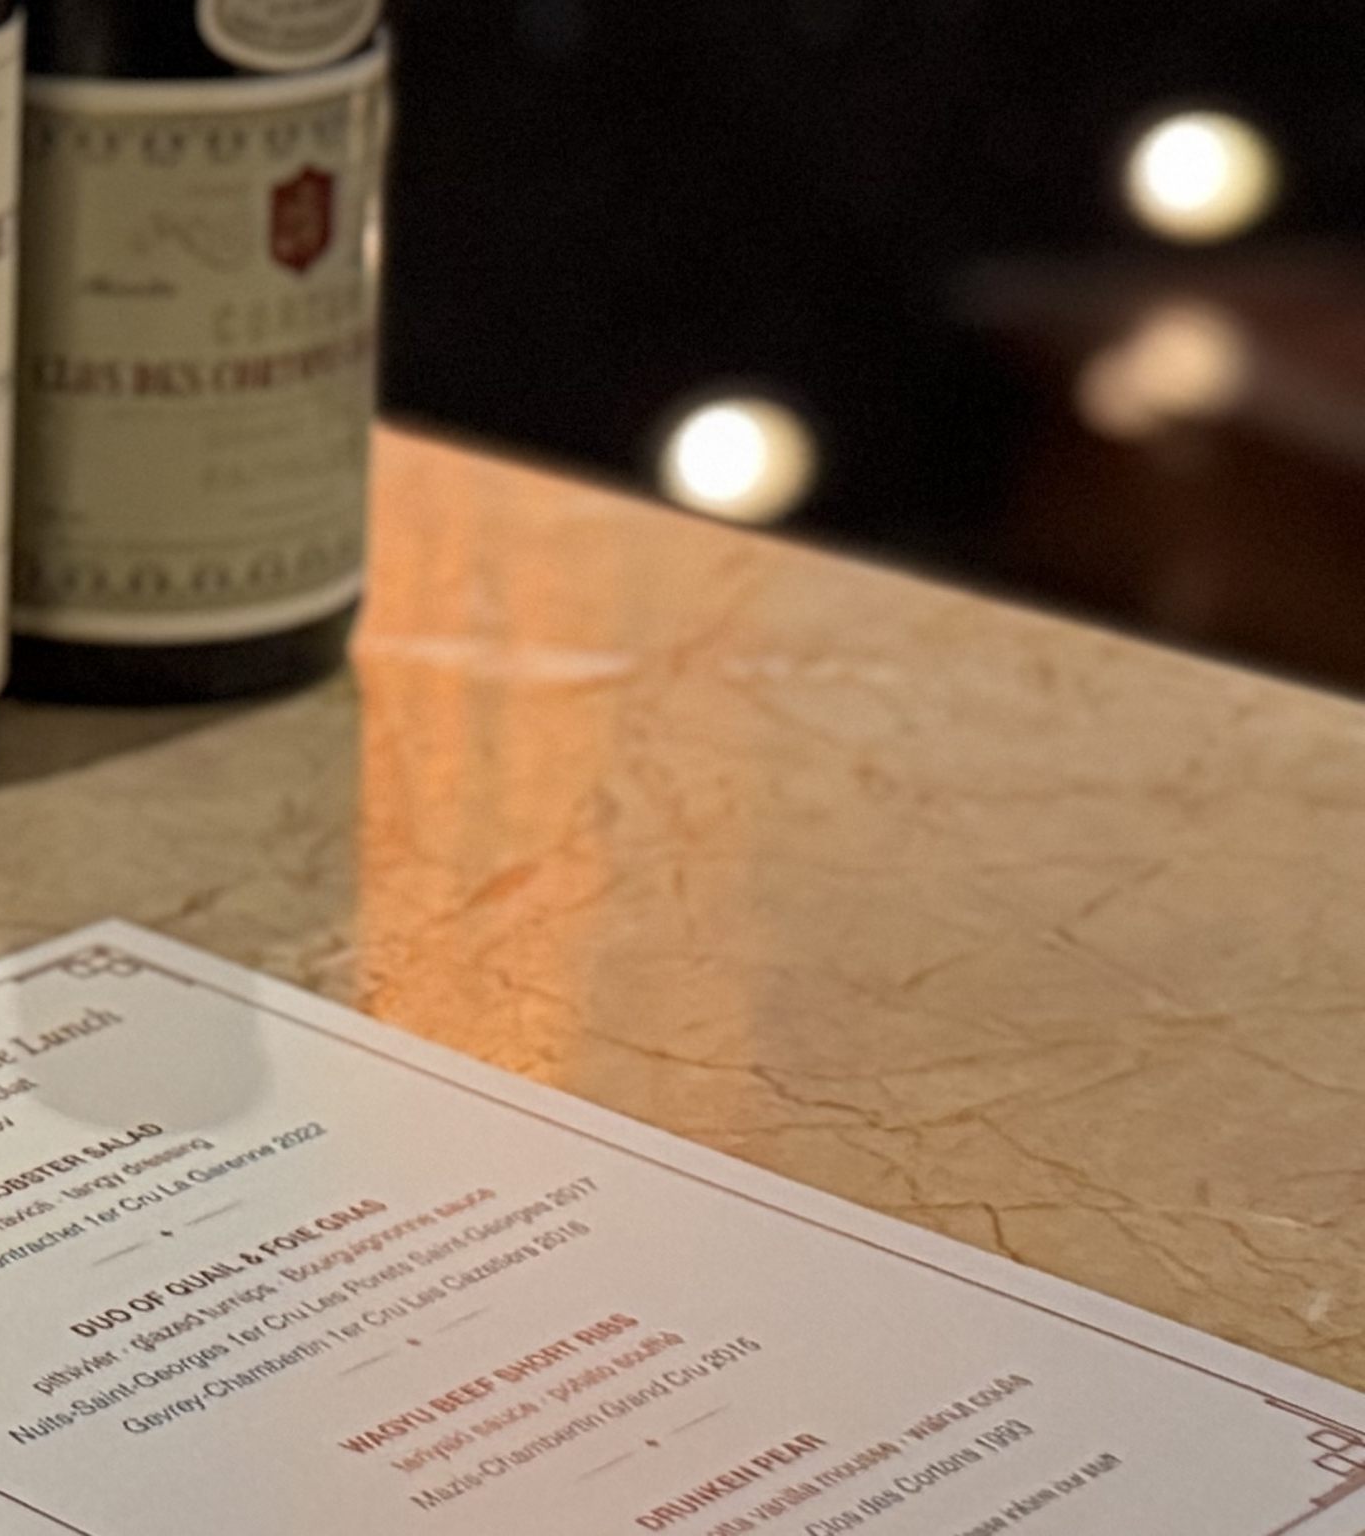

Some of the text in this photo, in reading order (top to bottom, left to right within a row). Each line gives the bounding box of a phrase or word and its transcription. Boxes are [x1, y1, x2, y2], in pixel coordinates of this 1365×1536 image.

[12, 1004, 124, 1058] Lunch
[61, 1171, 127, 1206] tangy
[81, 1121, 165, 1161] SALAD
[83, 1206, 120, 1230] 1er
[119, 1190, 164, 1213] Cru
[161, 1177, 191, 1197] La
[186, 1144, 275, 1185] Garenne
[271, 1120, 328, 1150] 2022
[8, 1343, 230, 1445] Nuits-Saint-Georges
[226, 1326, 267, 1347] 1er
[262, 1307, 310, 1332] Cru
[302, 1289, 348, 1314] Les
[545, 1176, 599, 1207] 2017
[70, 1198, 389, 1339] DUO OF QUAIL & FOIE GRAS
[122, 1334, 330, 1435] Gevrey-Chambertin
[326, 1321, 366, 1344] 1er
[361, 1303, 408, 1327] Cru
[400, 1285, 447, 1310] Les
[129, 1309, 206, 1354] glazed
[337, 1312, 640, 1456] WAGYU BEEF SHORT RIBS
[410, 1411, 607, 1511] Mazis-Chambertin
[598, 1379, 671, 1420] Grand
[662, 1360, 709, 1386] Cru
[635, 1433, 829, 1532] DRUNKEN PEAR
